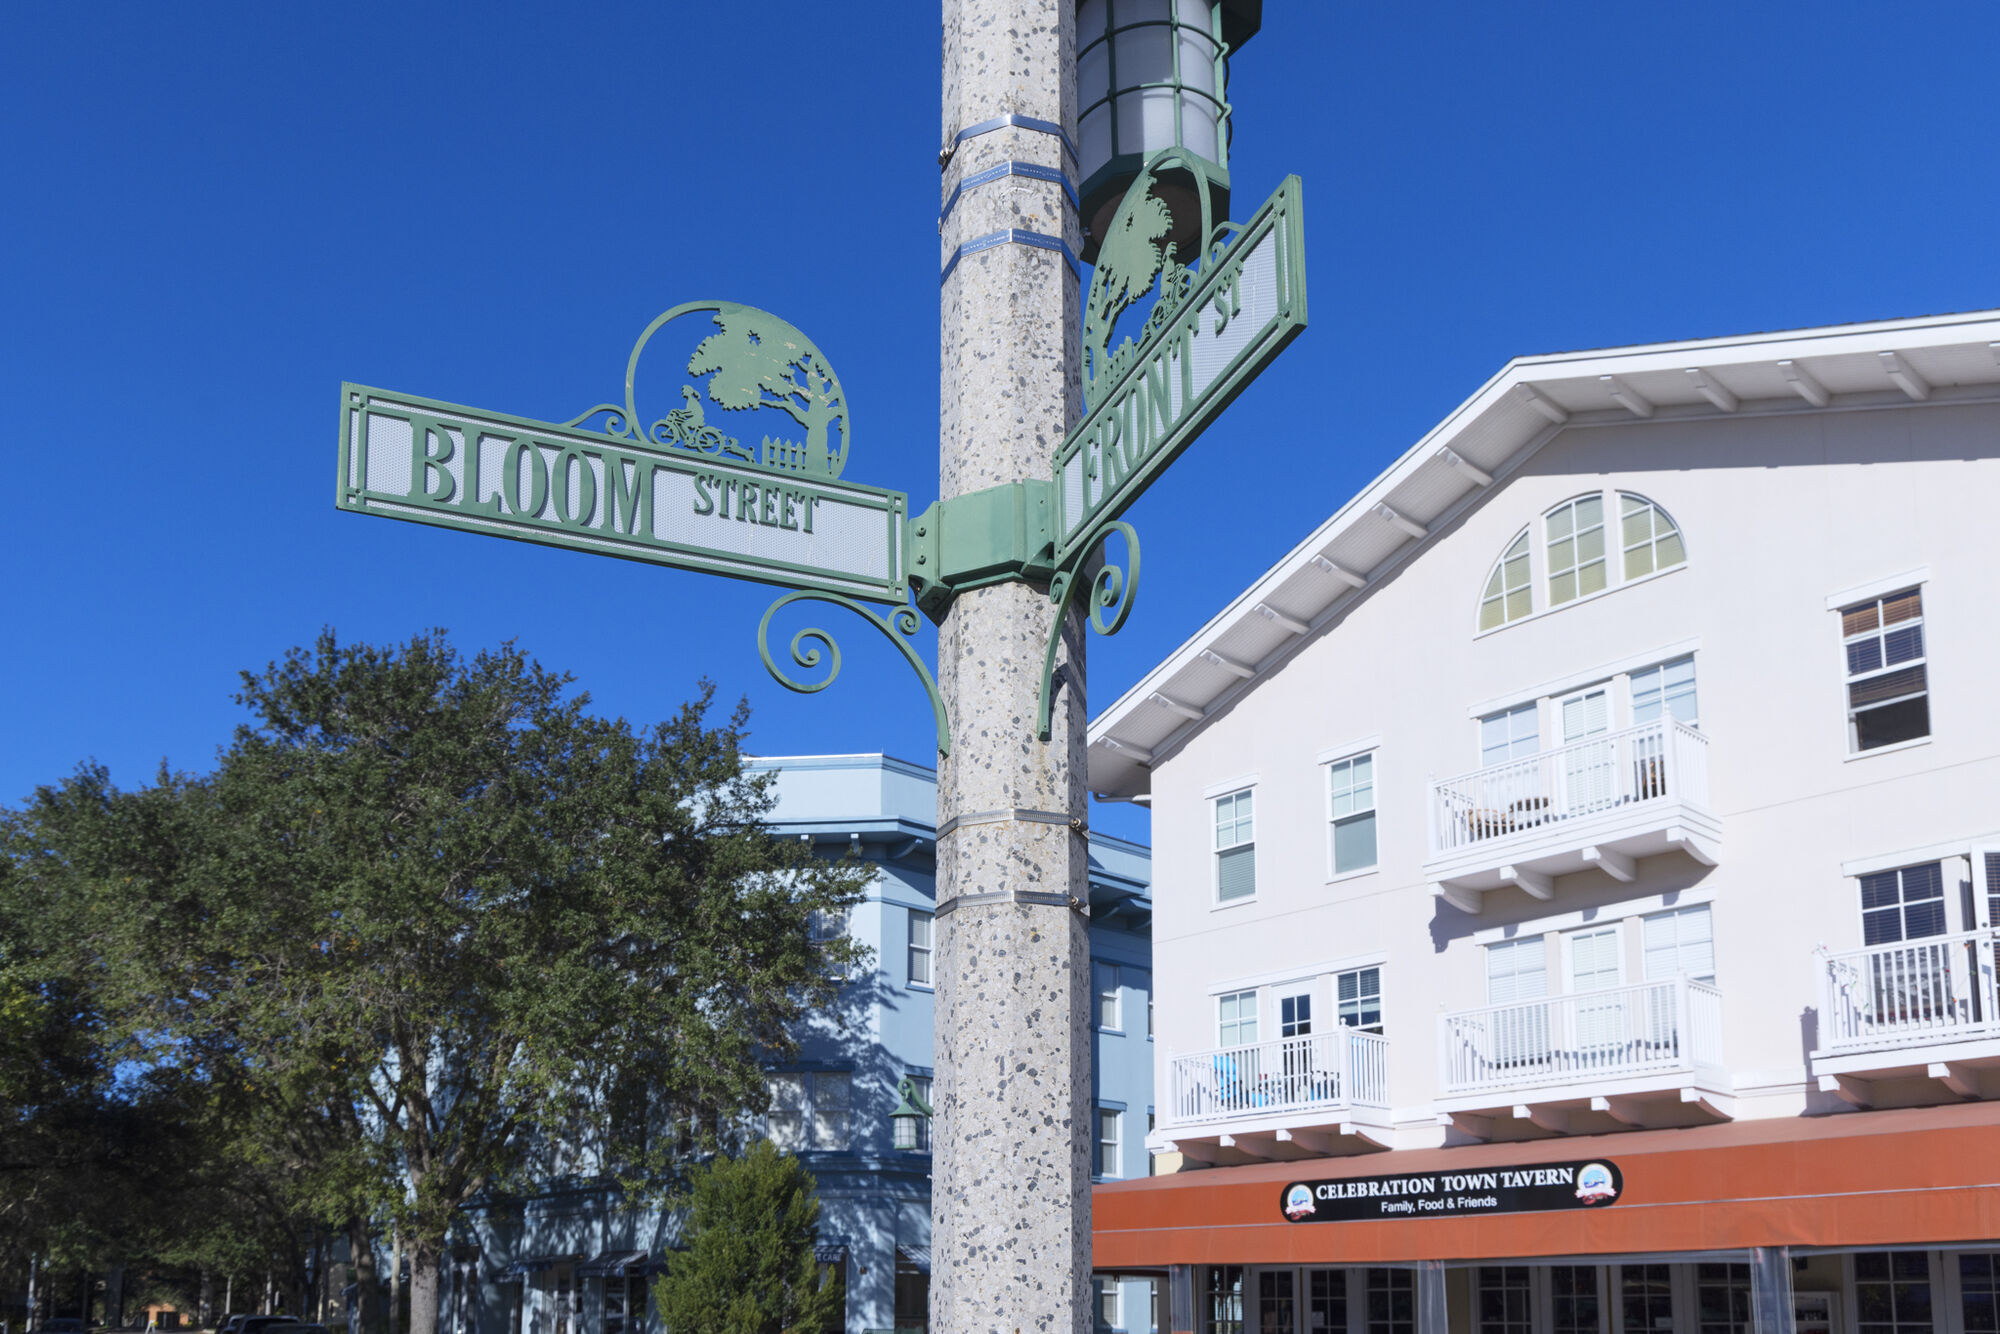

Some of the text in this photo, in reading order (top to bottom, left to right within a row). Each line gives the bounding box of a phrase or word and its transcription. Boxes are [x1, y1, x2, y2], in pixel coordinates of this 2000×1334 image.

[1080, 259, 1244, 519] FRONT ST
[407, 419, 819, 538] BLOOM STREET
[1315, 1167, 1574, 1200] CELEBRATION TOWN TAVERN
[1381, 1195, 1498, 1214] Family, Food & Friends
